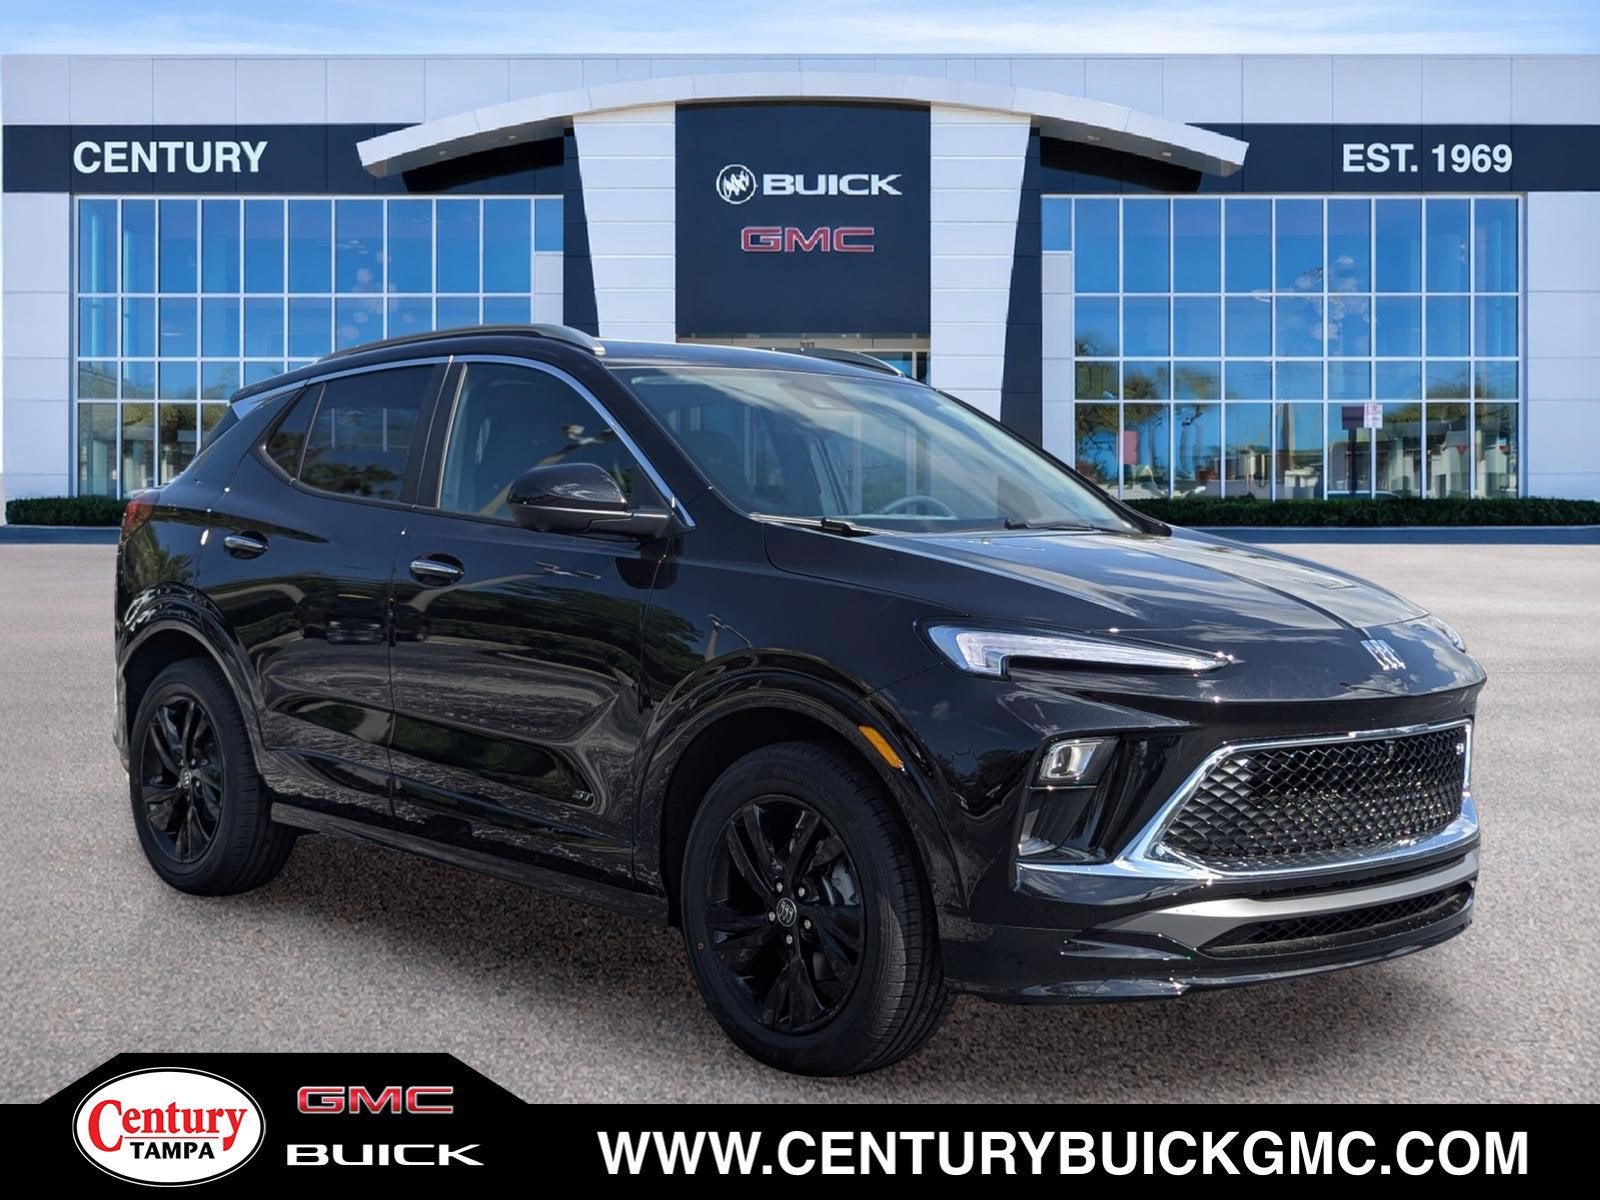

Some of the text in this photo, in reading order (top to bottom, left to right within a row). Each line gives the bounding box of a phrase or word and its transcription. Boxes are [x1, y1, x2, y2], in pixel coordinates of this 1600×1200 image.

[73, 140, 268, 174] CENTURY
[1342, 143, 1513, 173] EST. 1969
[762, 173, 903, 196] BUICK
[741, 226, 875, 253] GMC
